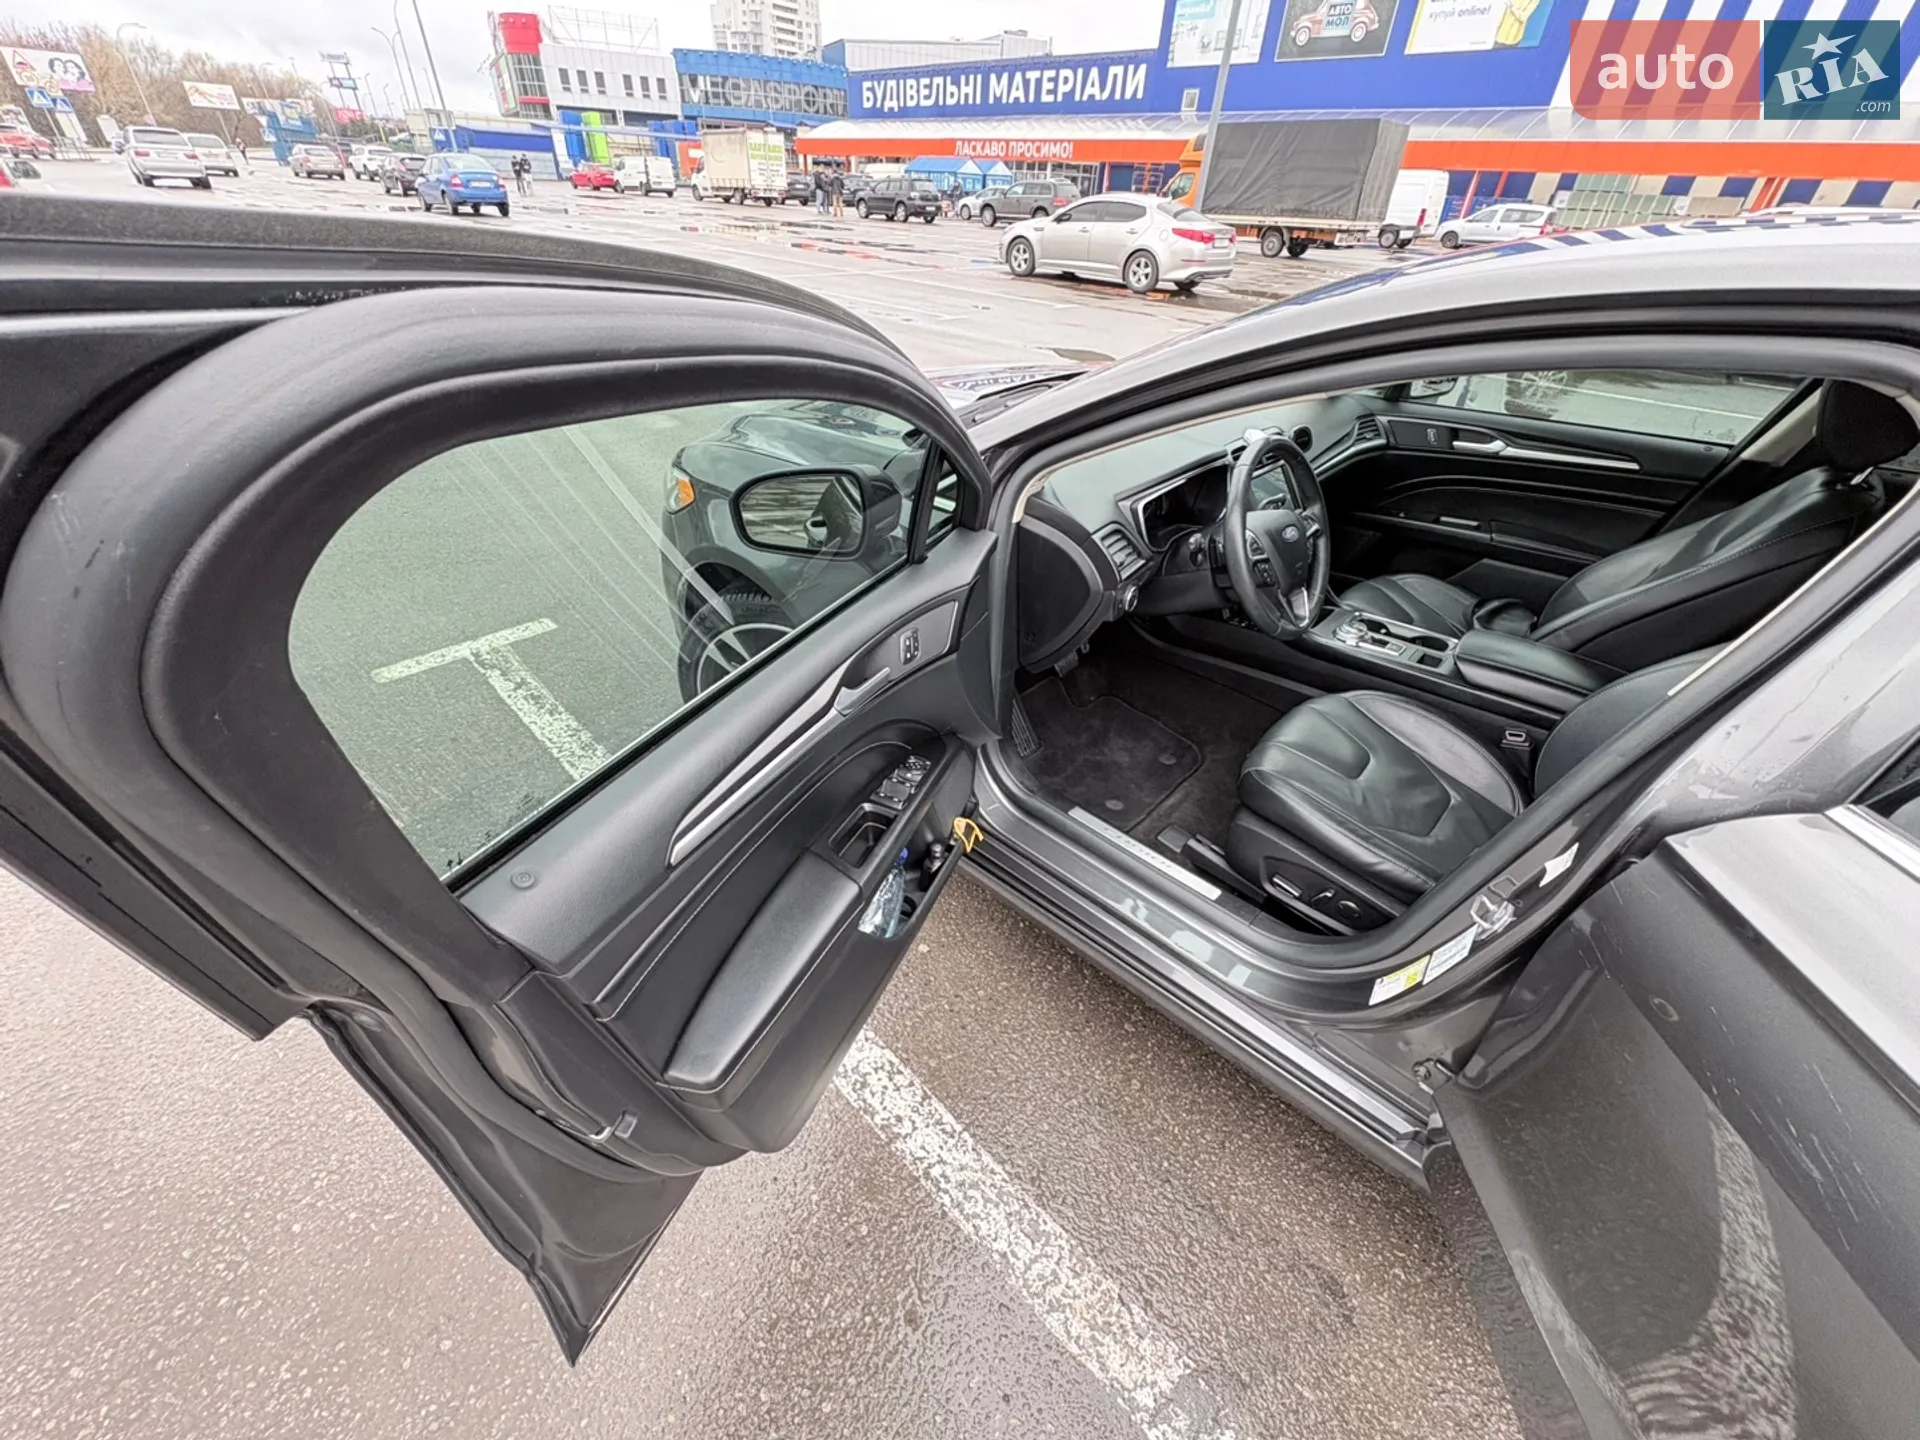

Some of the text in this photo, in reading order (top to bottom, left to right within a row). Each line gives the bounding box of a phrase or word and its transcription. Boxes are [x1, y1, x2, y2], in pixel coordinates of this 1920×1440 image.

[1328, 4, 1352, 16] АВТО
[1457, 4, 1492, 18] online!
[1325, 16, 1350, 28] МОЛ
[862, 63, 1147, 112] БУДІВЕЛЬНІ МАТЕРІАЛИ
[954, 140, 1074, 158] ЛАСКАВО ПРОСИМО!
